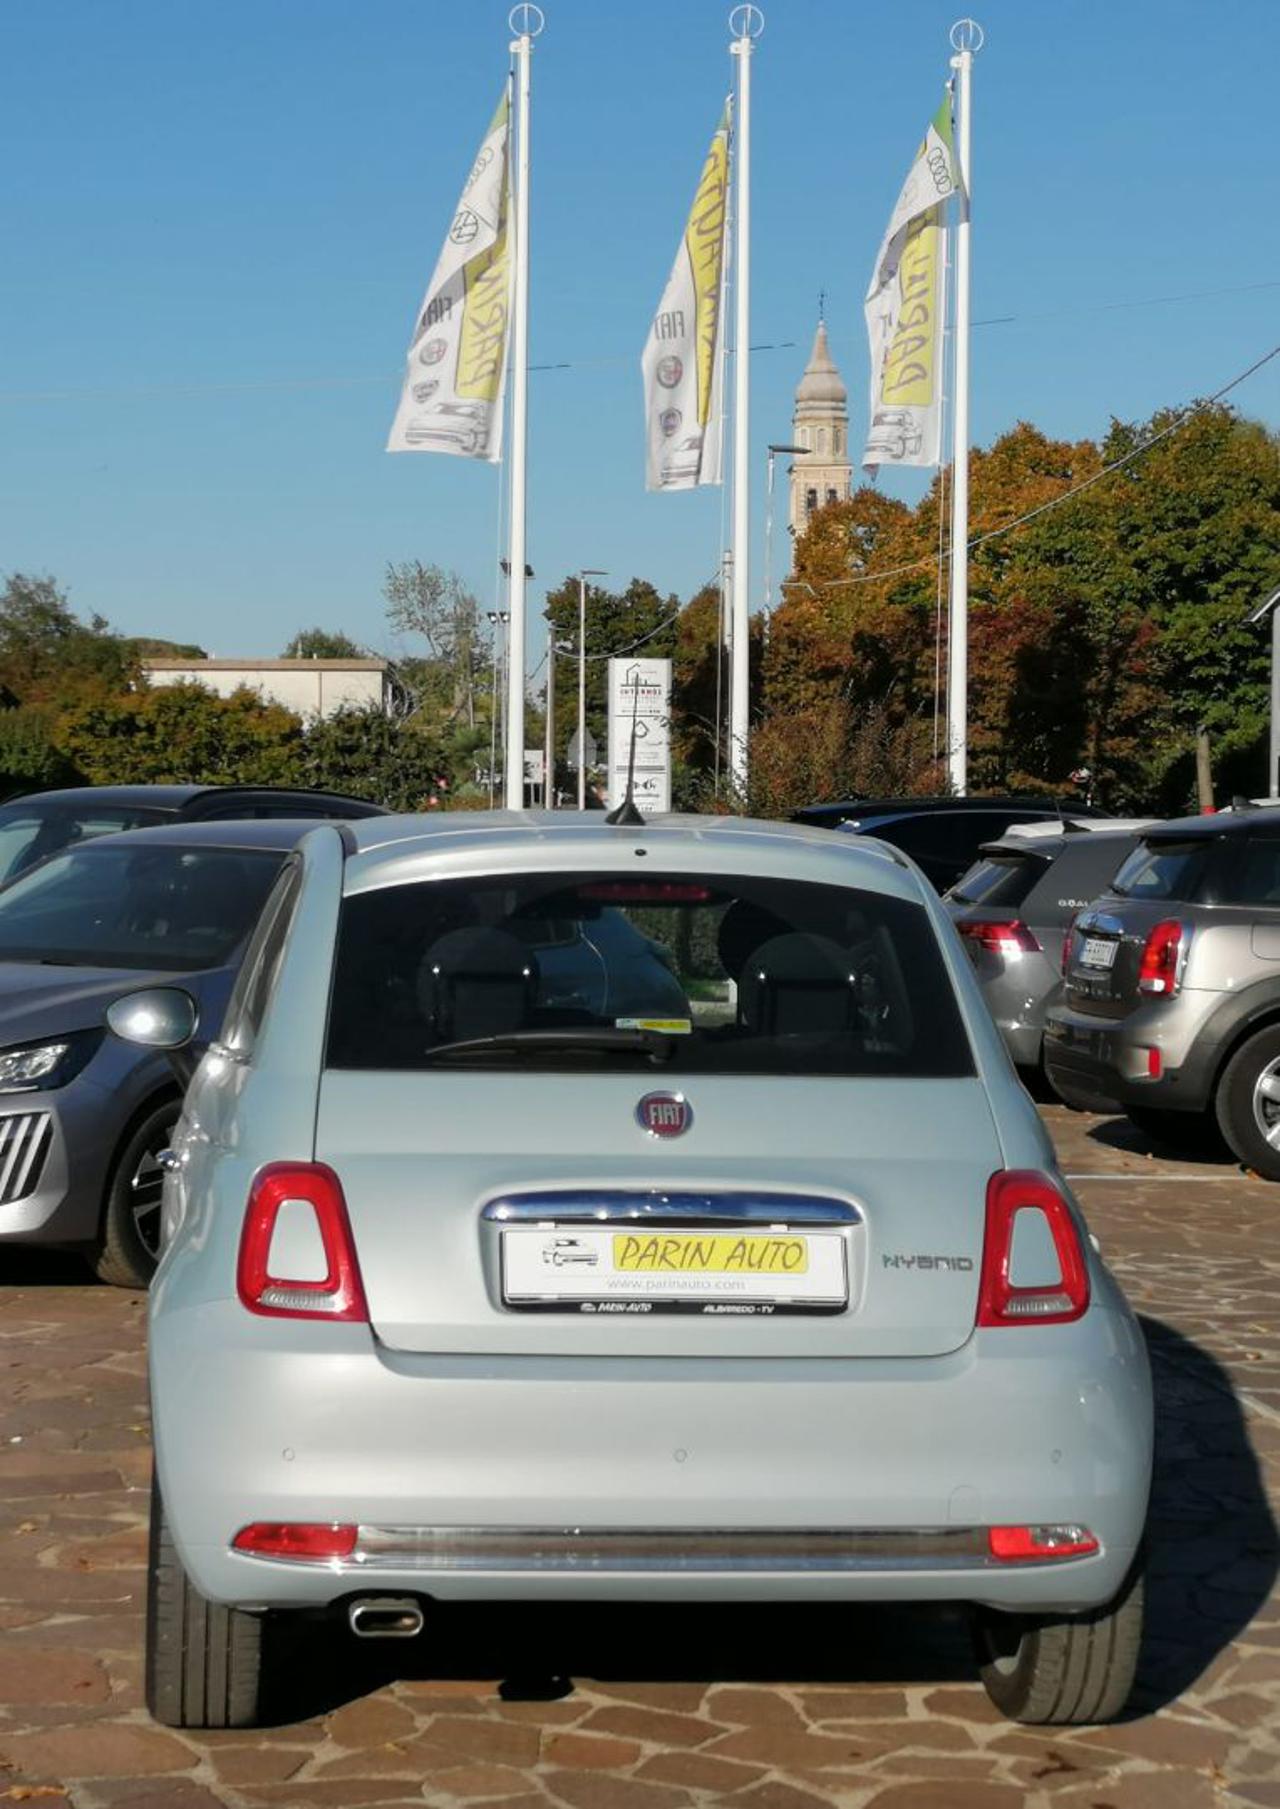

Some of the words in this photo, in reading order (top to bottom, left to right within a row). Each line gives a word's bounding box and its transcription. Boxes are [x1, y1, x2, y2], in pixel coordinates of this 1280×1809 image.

[649, 1103, 682, 1126] FIAT
[618, 1237, 716, 1269] PARIN
[723, 1240, 804, 1269] AUTO
[882, 1254, 974, 1272] HYBRID
[606, 1276, 746, 1291] www.parinauto.com
